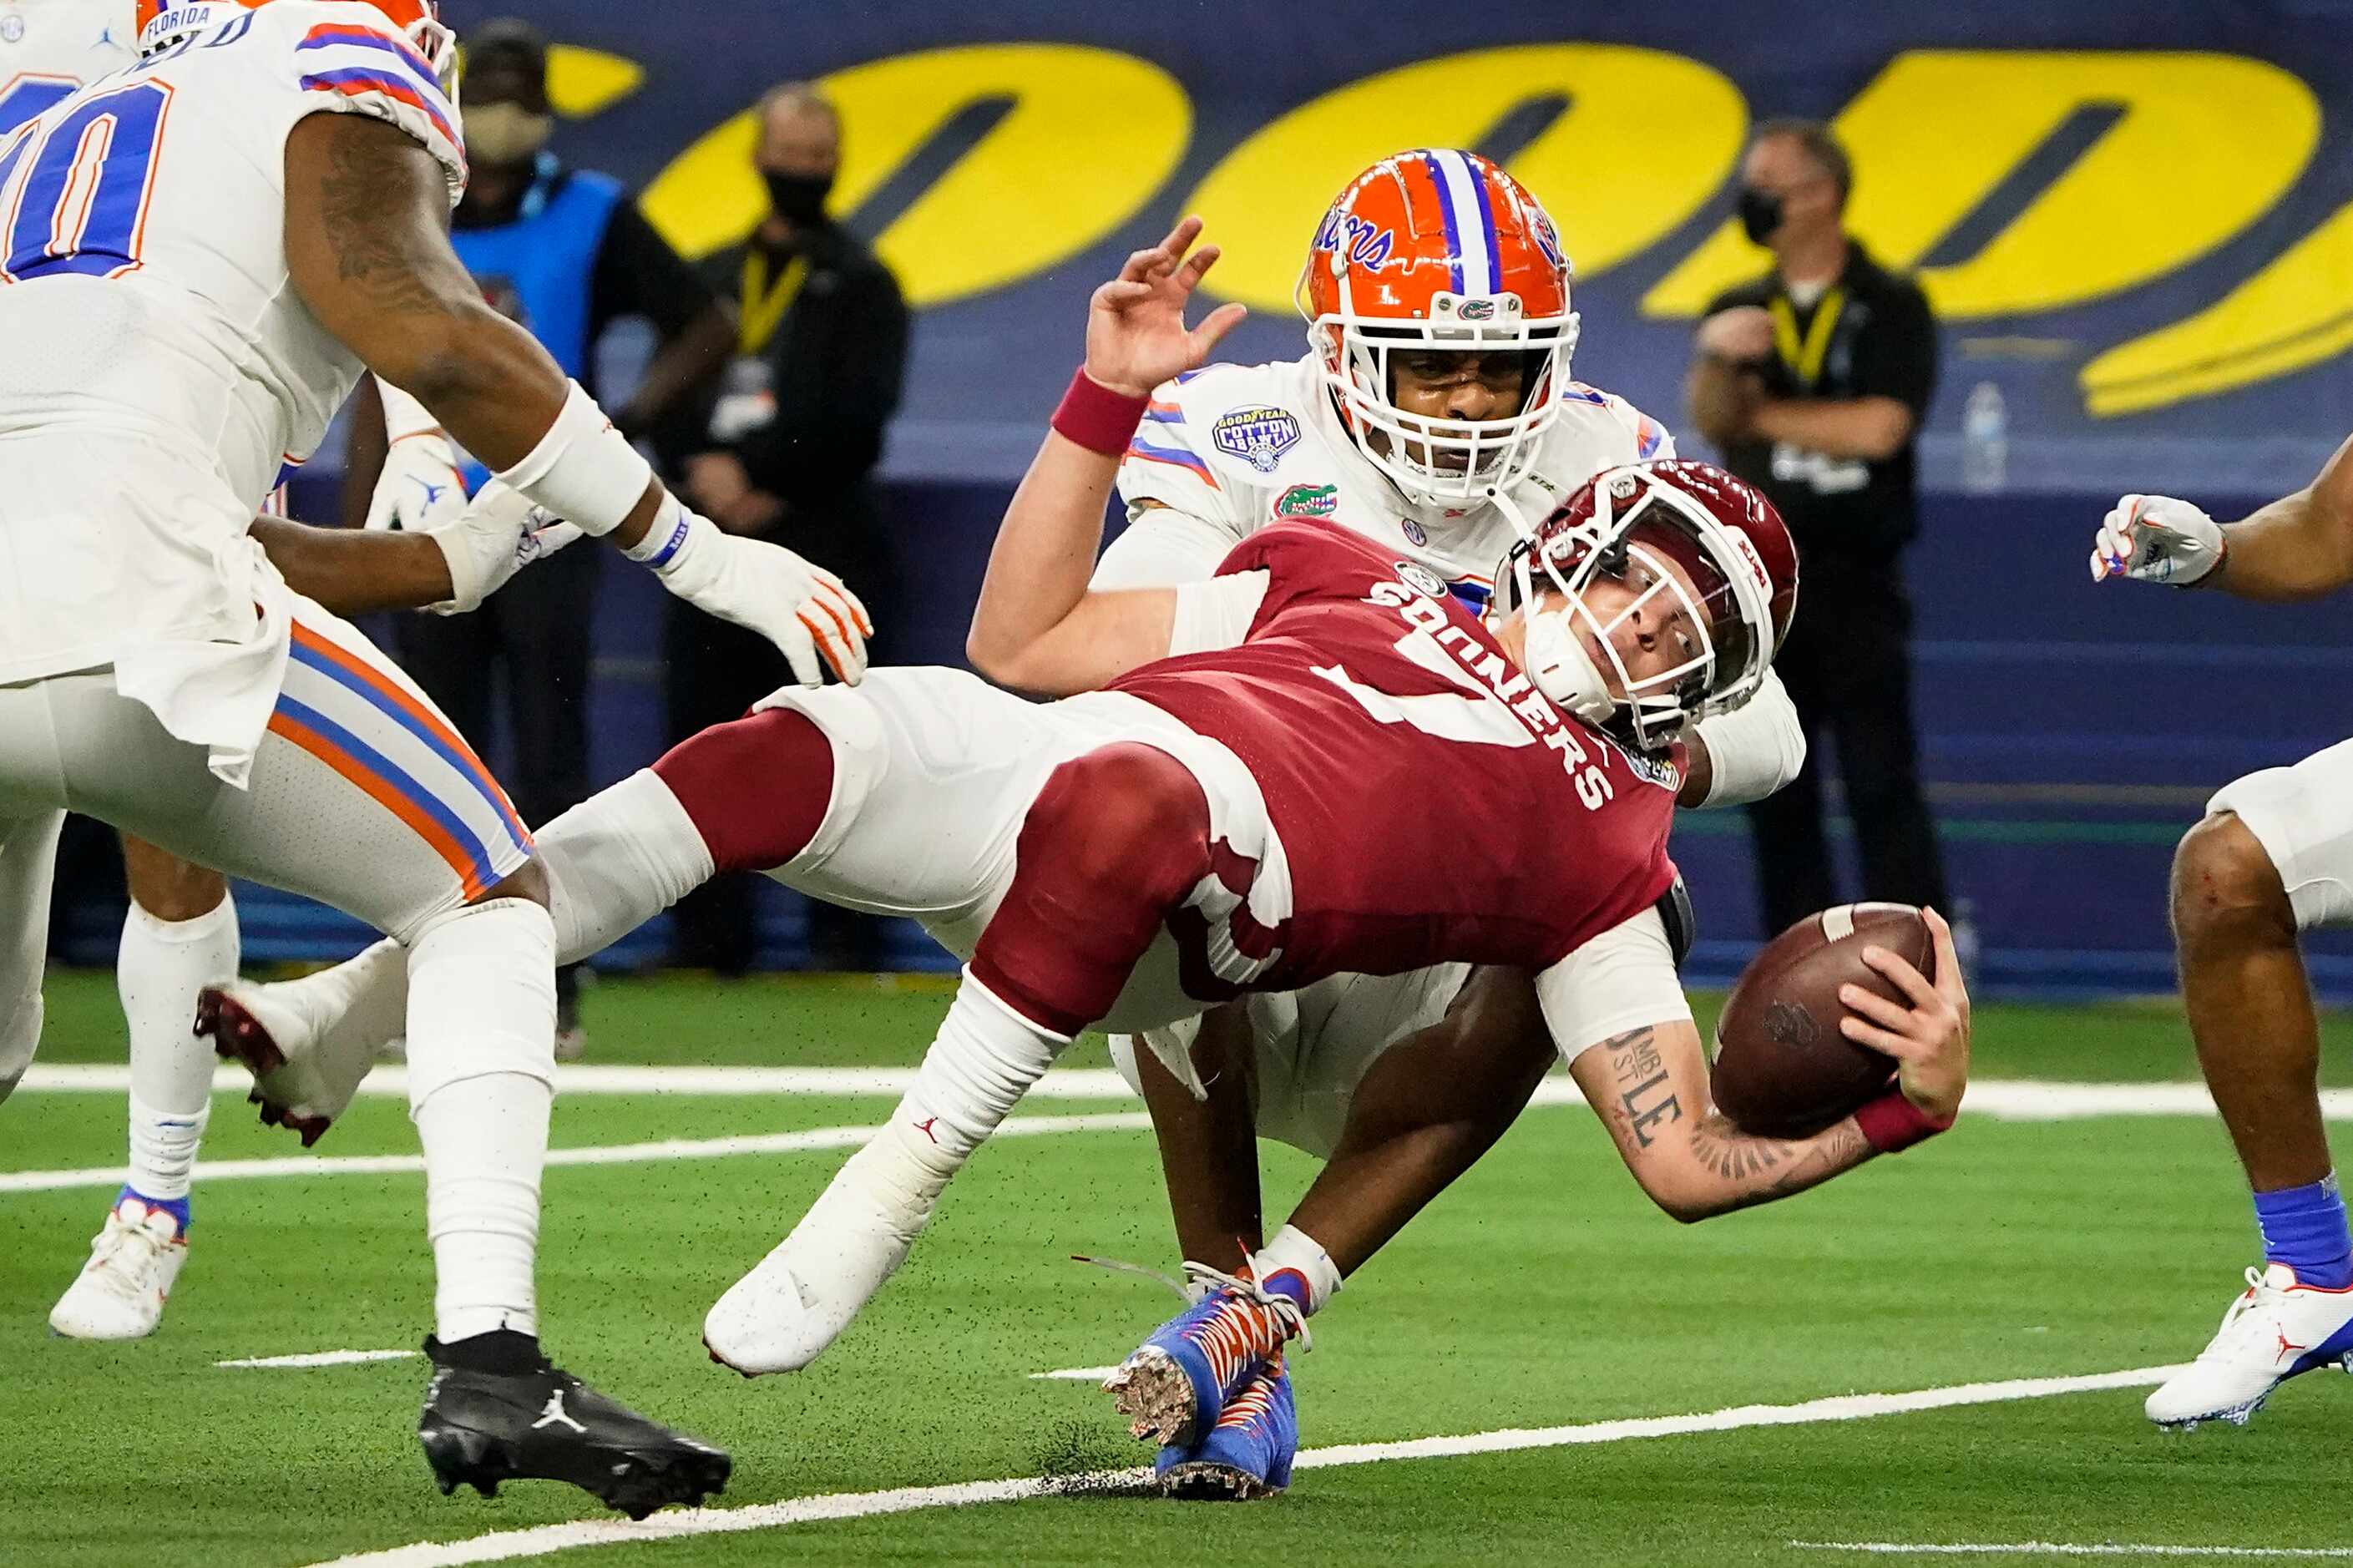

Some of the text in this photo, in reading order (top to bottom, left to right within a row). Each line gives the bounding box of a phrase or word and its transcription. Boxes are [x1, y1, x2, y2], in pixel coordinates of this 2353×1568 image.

[148, 7, 211, 41] FLORIDA
[543, 42, 2320, 321] OOD
[1217, 408, 1288, 428] GOODYEAR
[1218, 417, 1295, 449] COTTON
[1235, 432, 1284, 452] BOWL
[1308, 626, 1537, 748] 7
[1359, 580, 1614, 812] SOONERS
